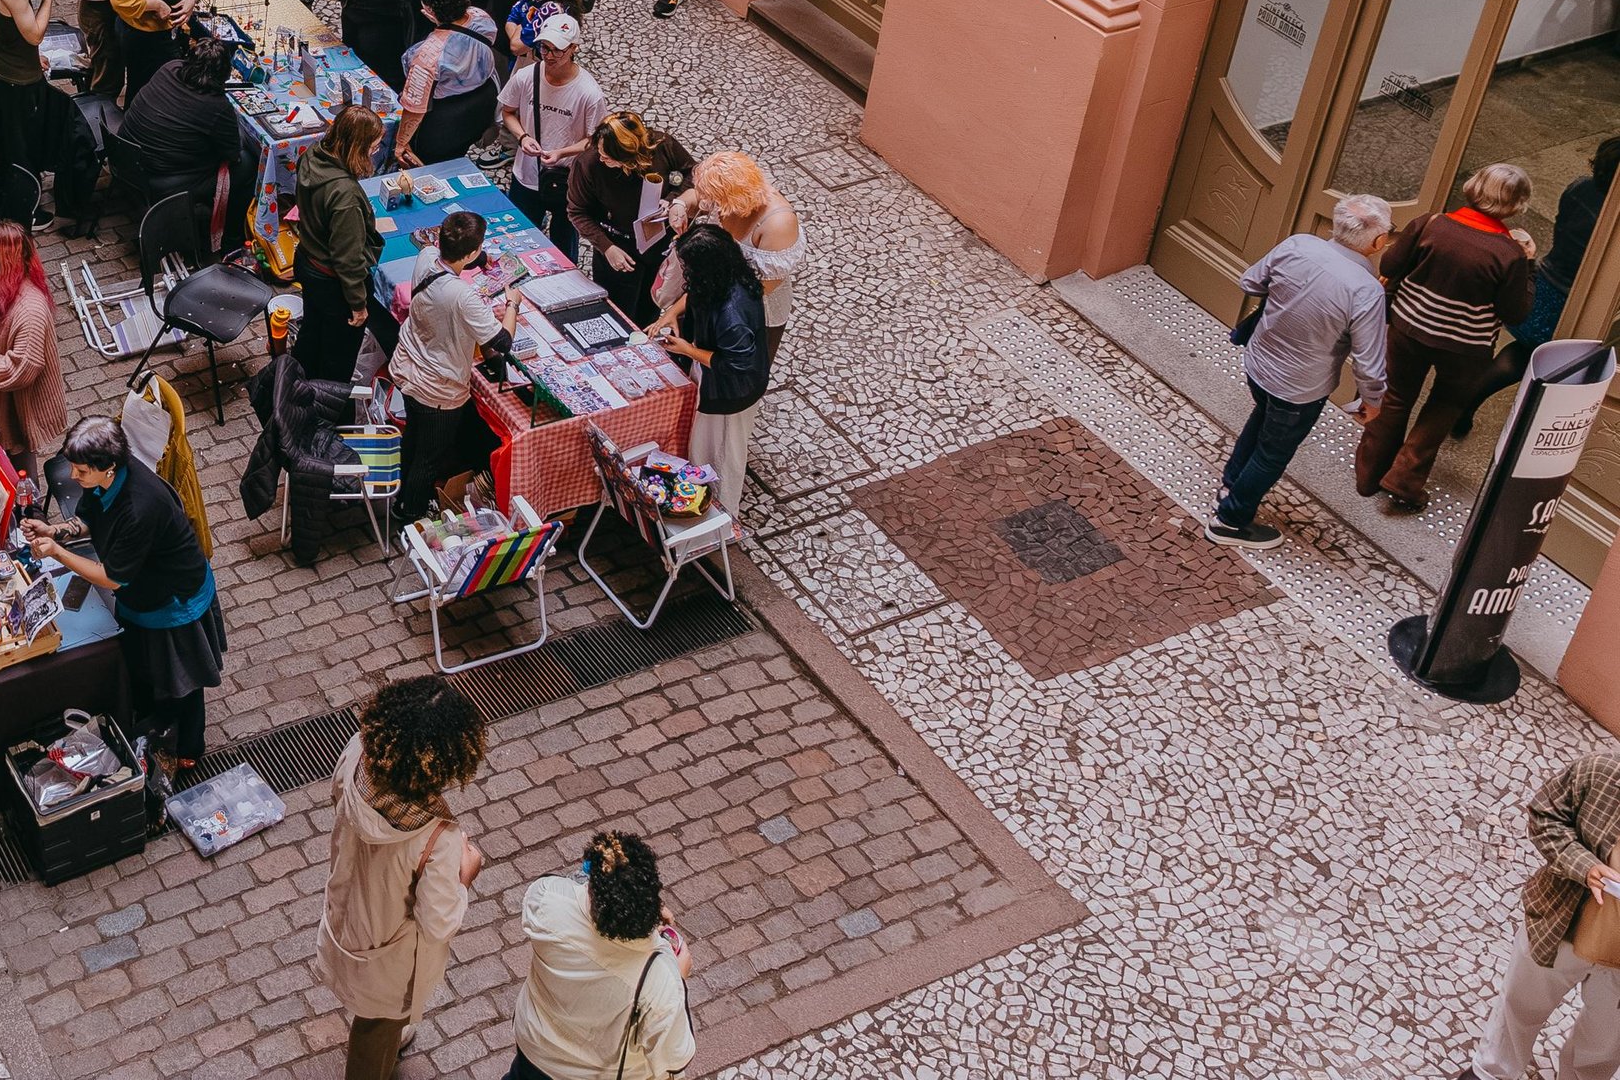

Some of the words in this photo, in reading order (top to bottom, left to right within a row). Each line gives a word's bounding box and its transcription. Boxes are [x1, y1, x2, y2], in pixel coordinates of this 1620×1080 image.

[1258, 8, 1277, 27] PAULO
[1278, 20, 1306, 43] AMORIM
[543, 104, 558, 112] your
[558, 108, 573, 117] milk
[1535, 431, 1577, 447] PAULO
[1467, 584, 1524, 615] AMO
